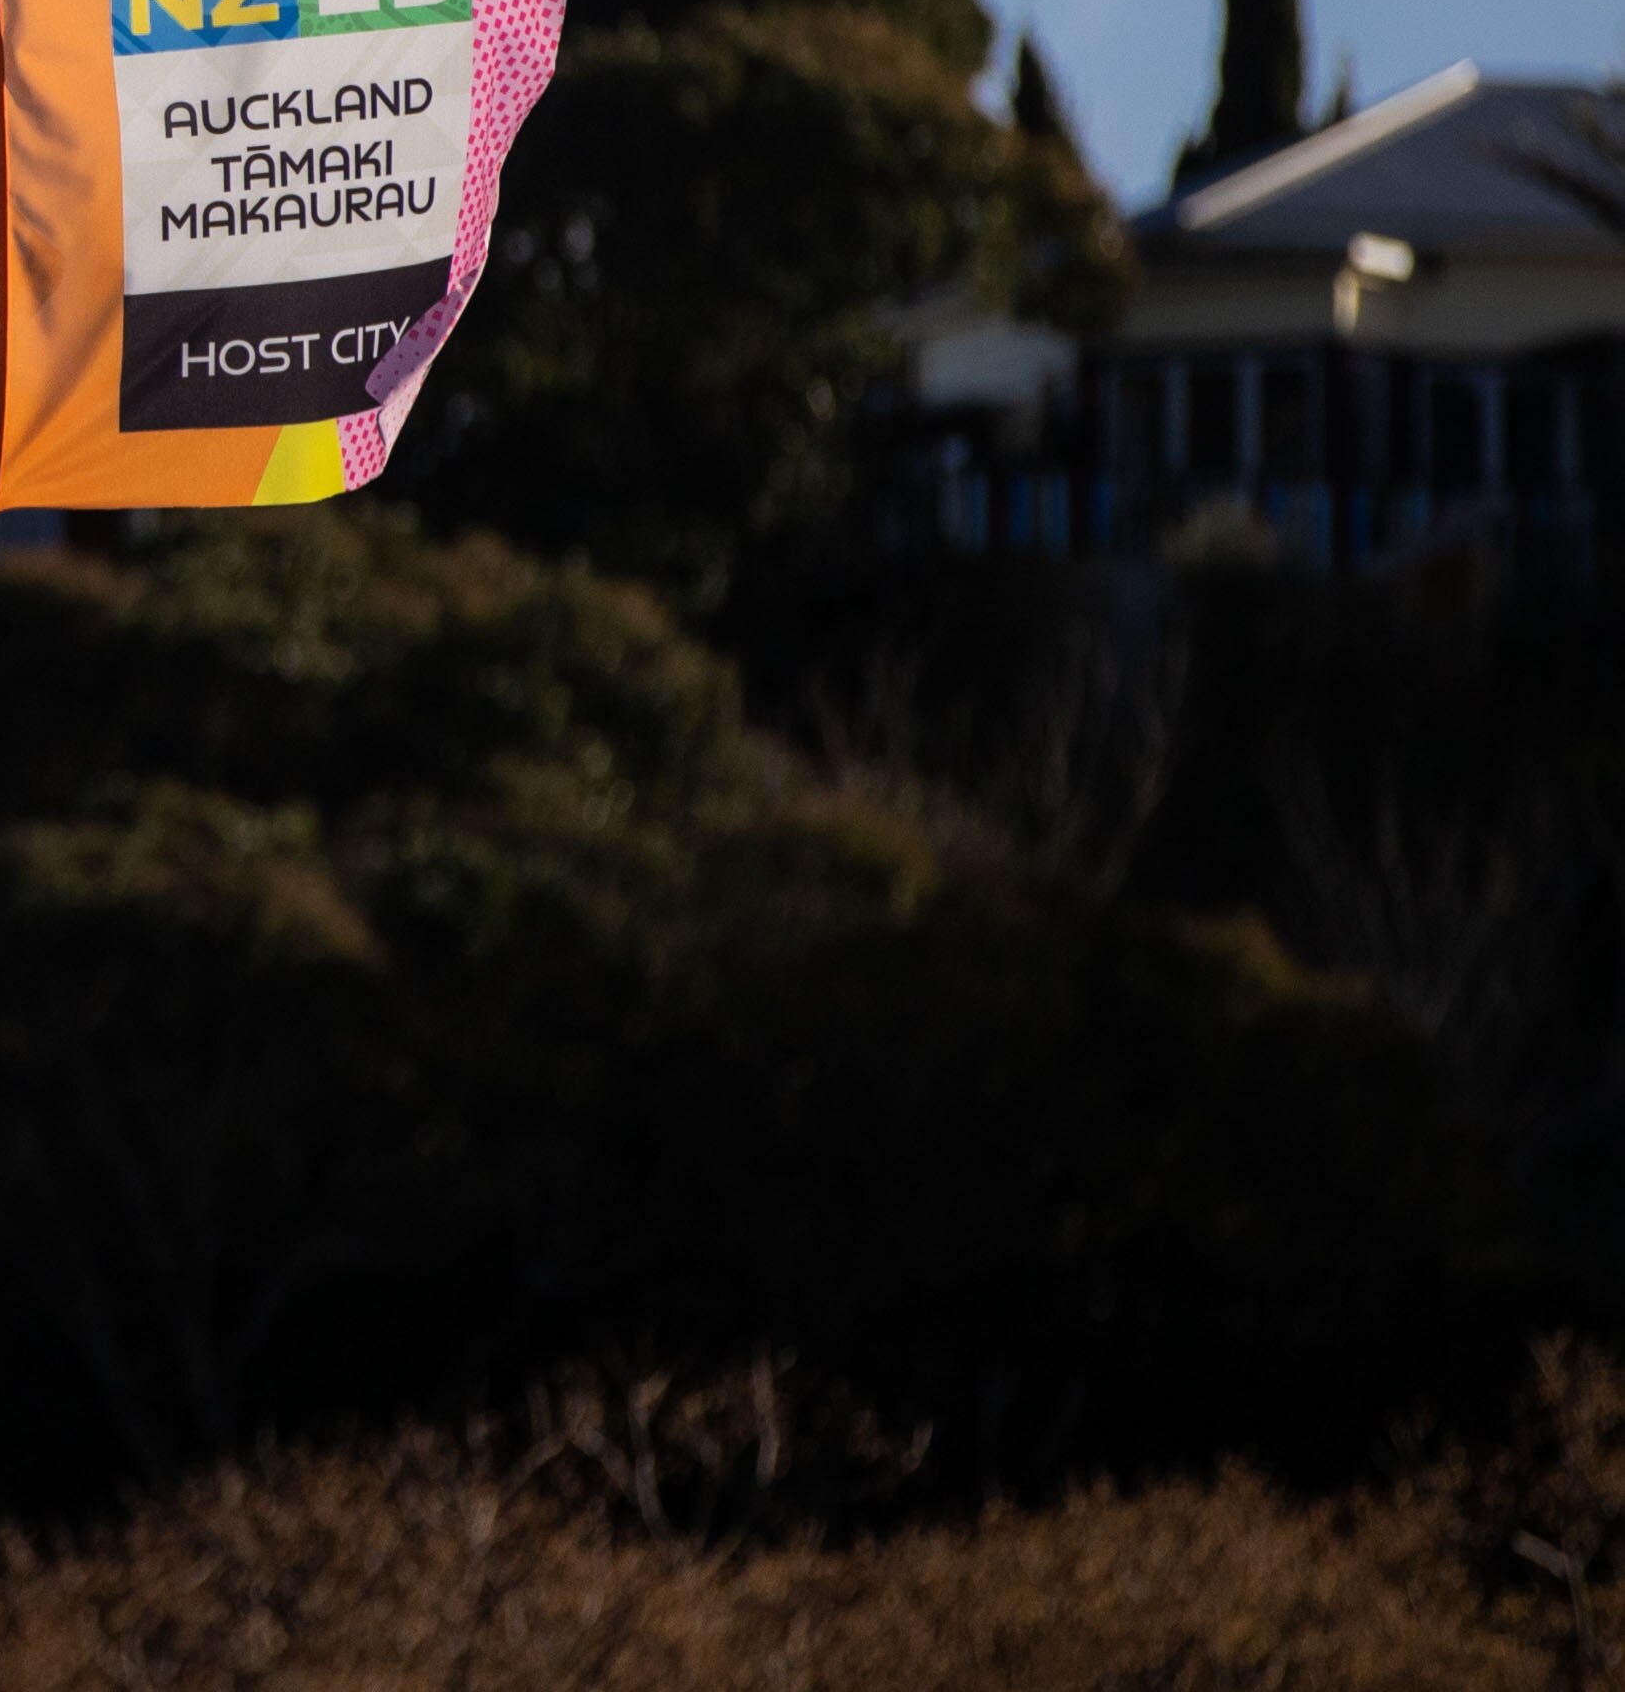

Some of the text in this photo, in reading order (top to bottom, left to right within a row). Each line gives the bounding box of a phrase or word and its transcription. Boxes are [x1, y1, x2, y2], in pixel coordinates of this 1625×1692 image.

[164, 78, 433, 138] AUCKLAND
[211, 140, 393, 192] TĀMAKI
[161, 177, 436, 242] MAKAURAU
[181, 316, 411, 378] HOST CITY
